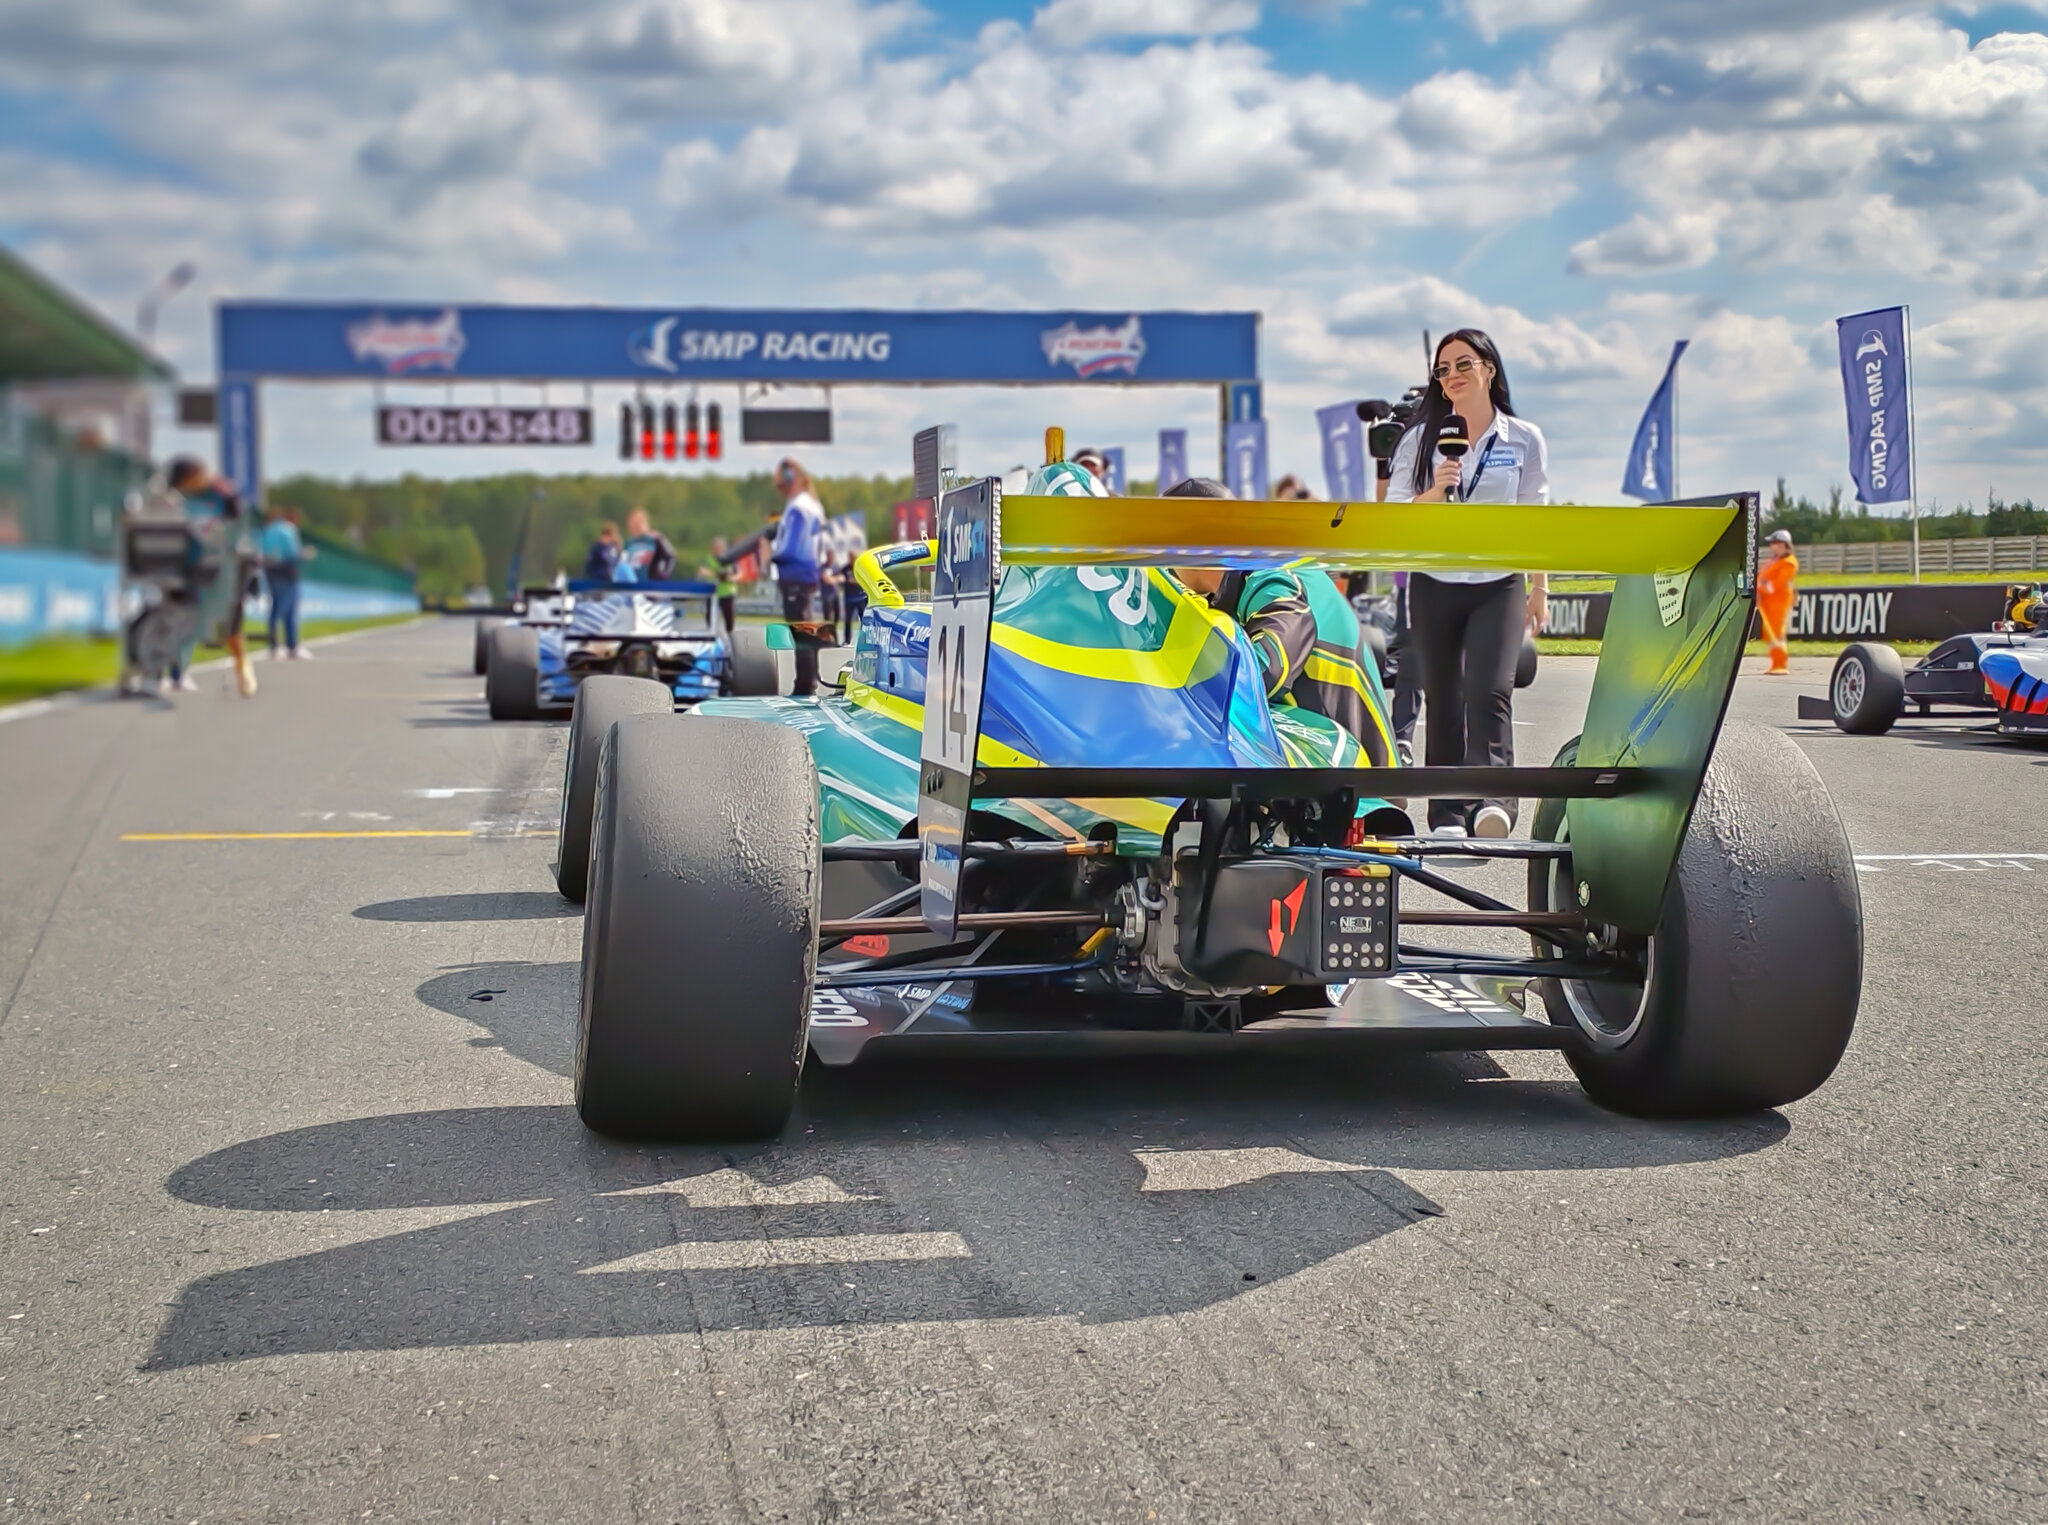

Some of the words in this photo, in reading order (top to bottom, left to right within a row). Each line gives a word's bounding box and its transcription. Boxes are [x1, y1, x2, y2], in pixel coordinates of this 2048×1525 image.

[680, 331, 757, 360] SMP
[761, 332, 890, 361] RACING
[388, 408, 581, 441] 00:03:48
[1787, 594, 1816, 635] EN
[1820, 592, 1893, 635] TODAY
[938, 625, 965, 763] 14
[908, 987, 931, 999] SMP
